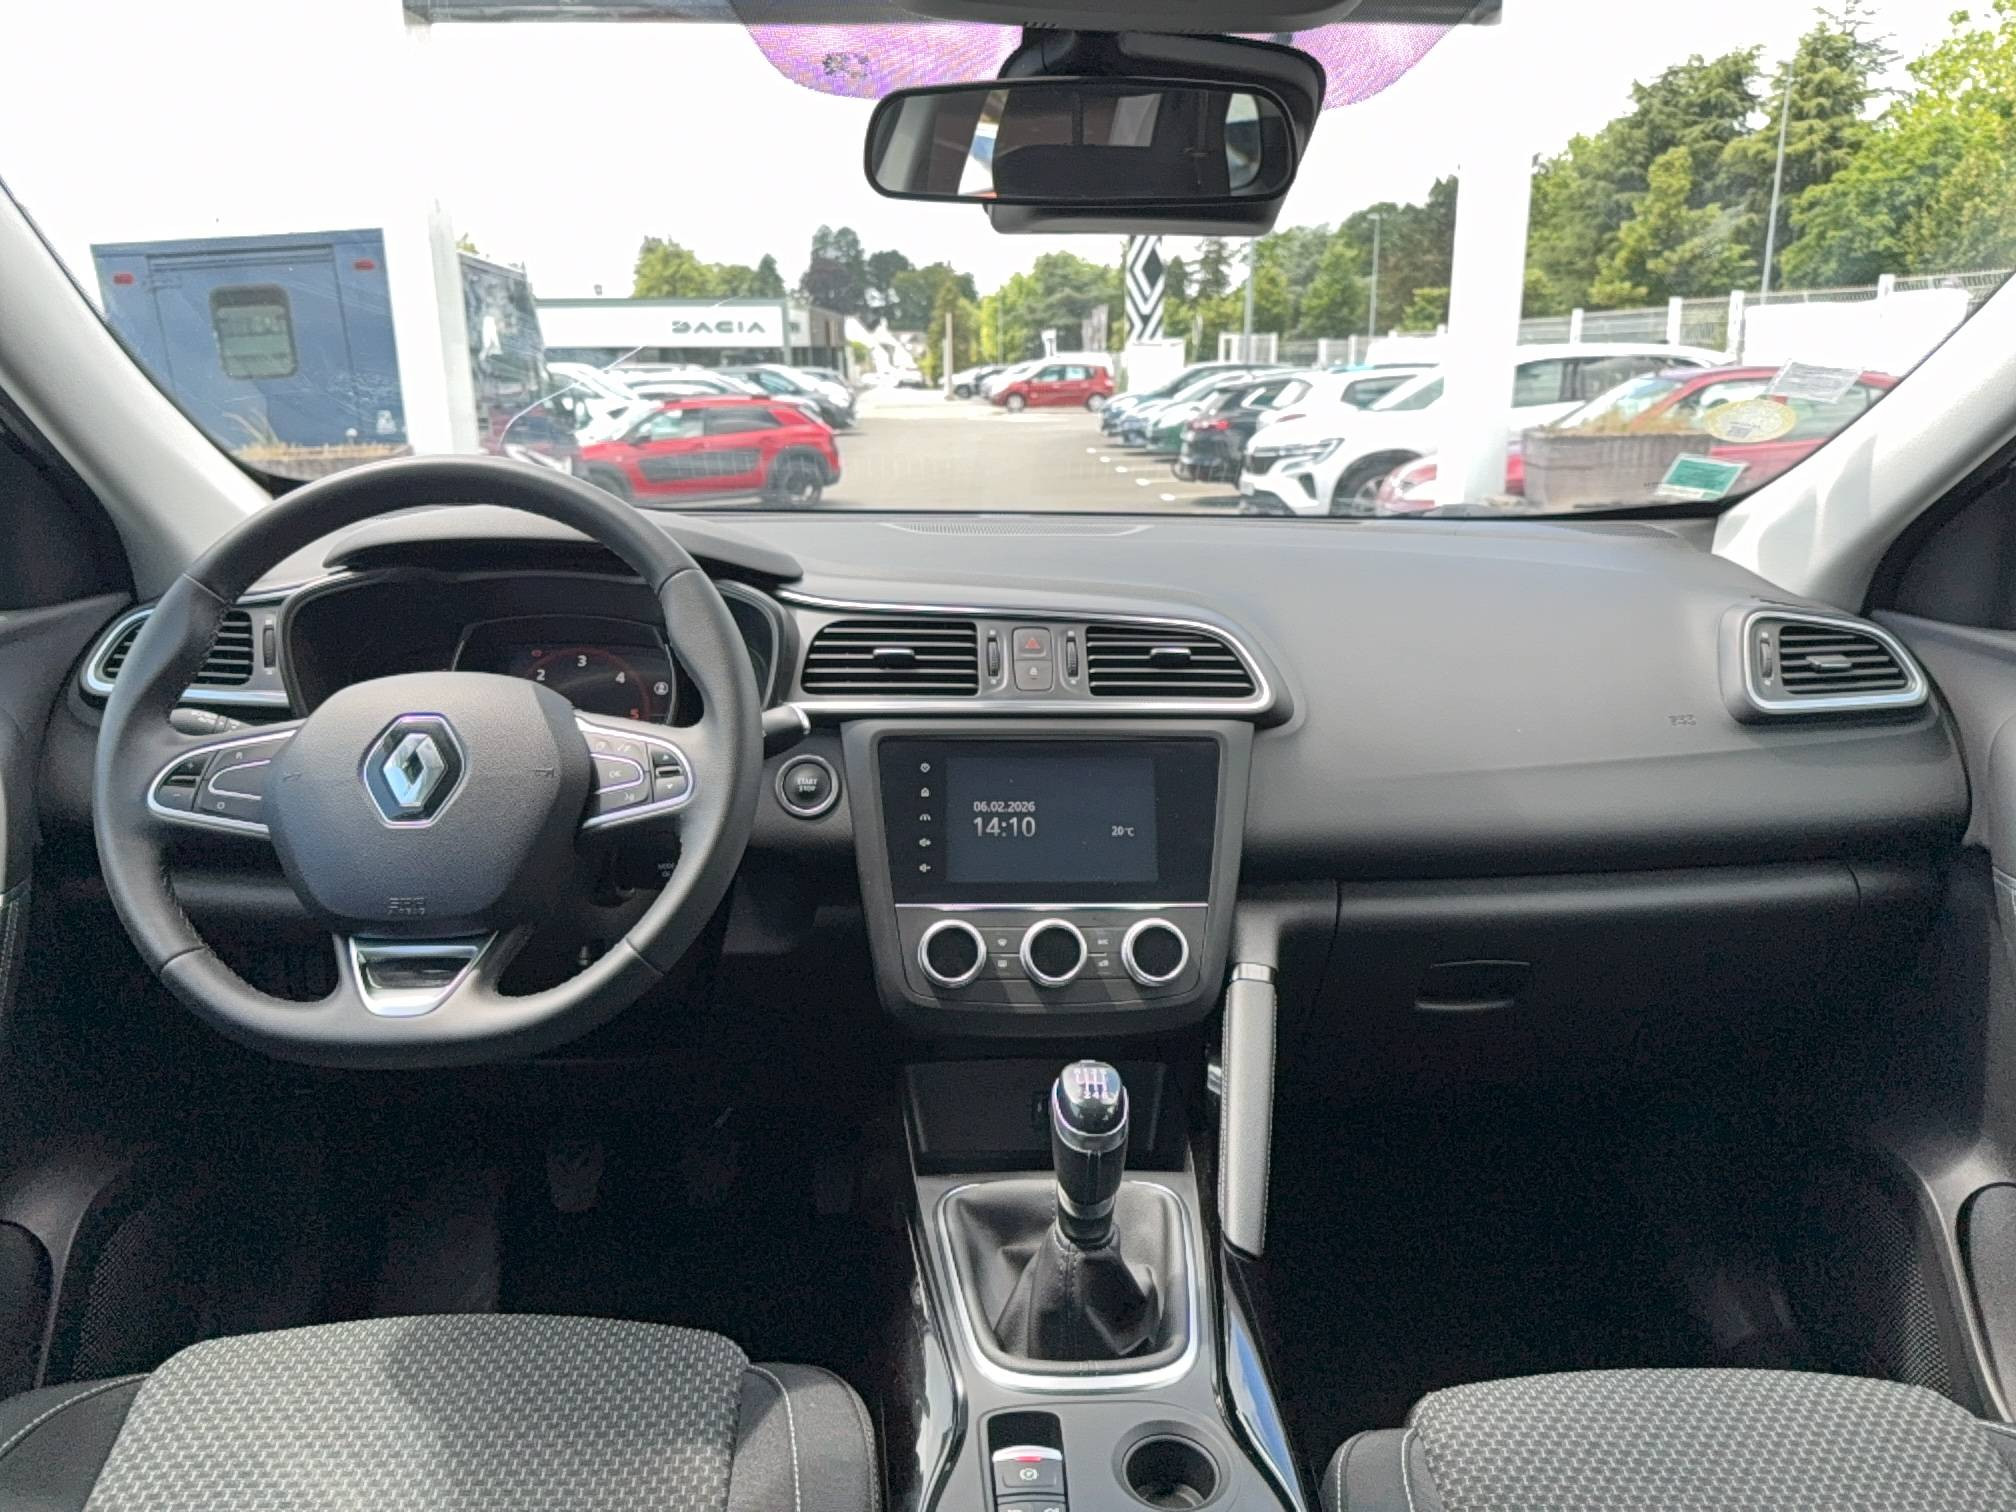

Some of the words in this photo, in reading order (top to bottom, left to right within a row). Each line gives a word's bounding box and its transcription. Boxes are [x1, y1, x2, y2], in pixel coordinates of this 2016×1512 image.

[672, 320, 766, 334] DACIA
[577, 655, 587, 667] 3
[536, 669, 546, 681] 2
[615, 671, 626, 684] 4
[973, 801, 1036, 813] 06.02.2026
[973, 816, 1036, 837] 14:10
